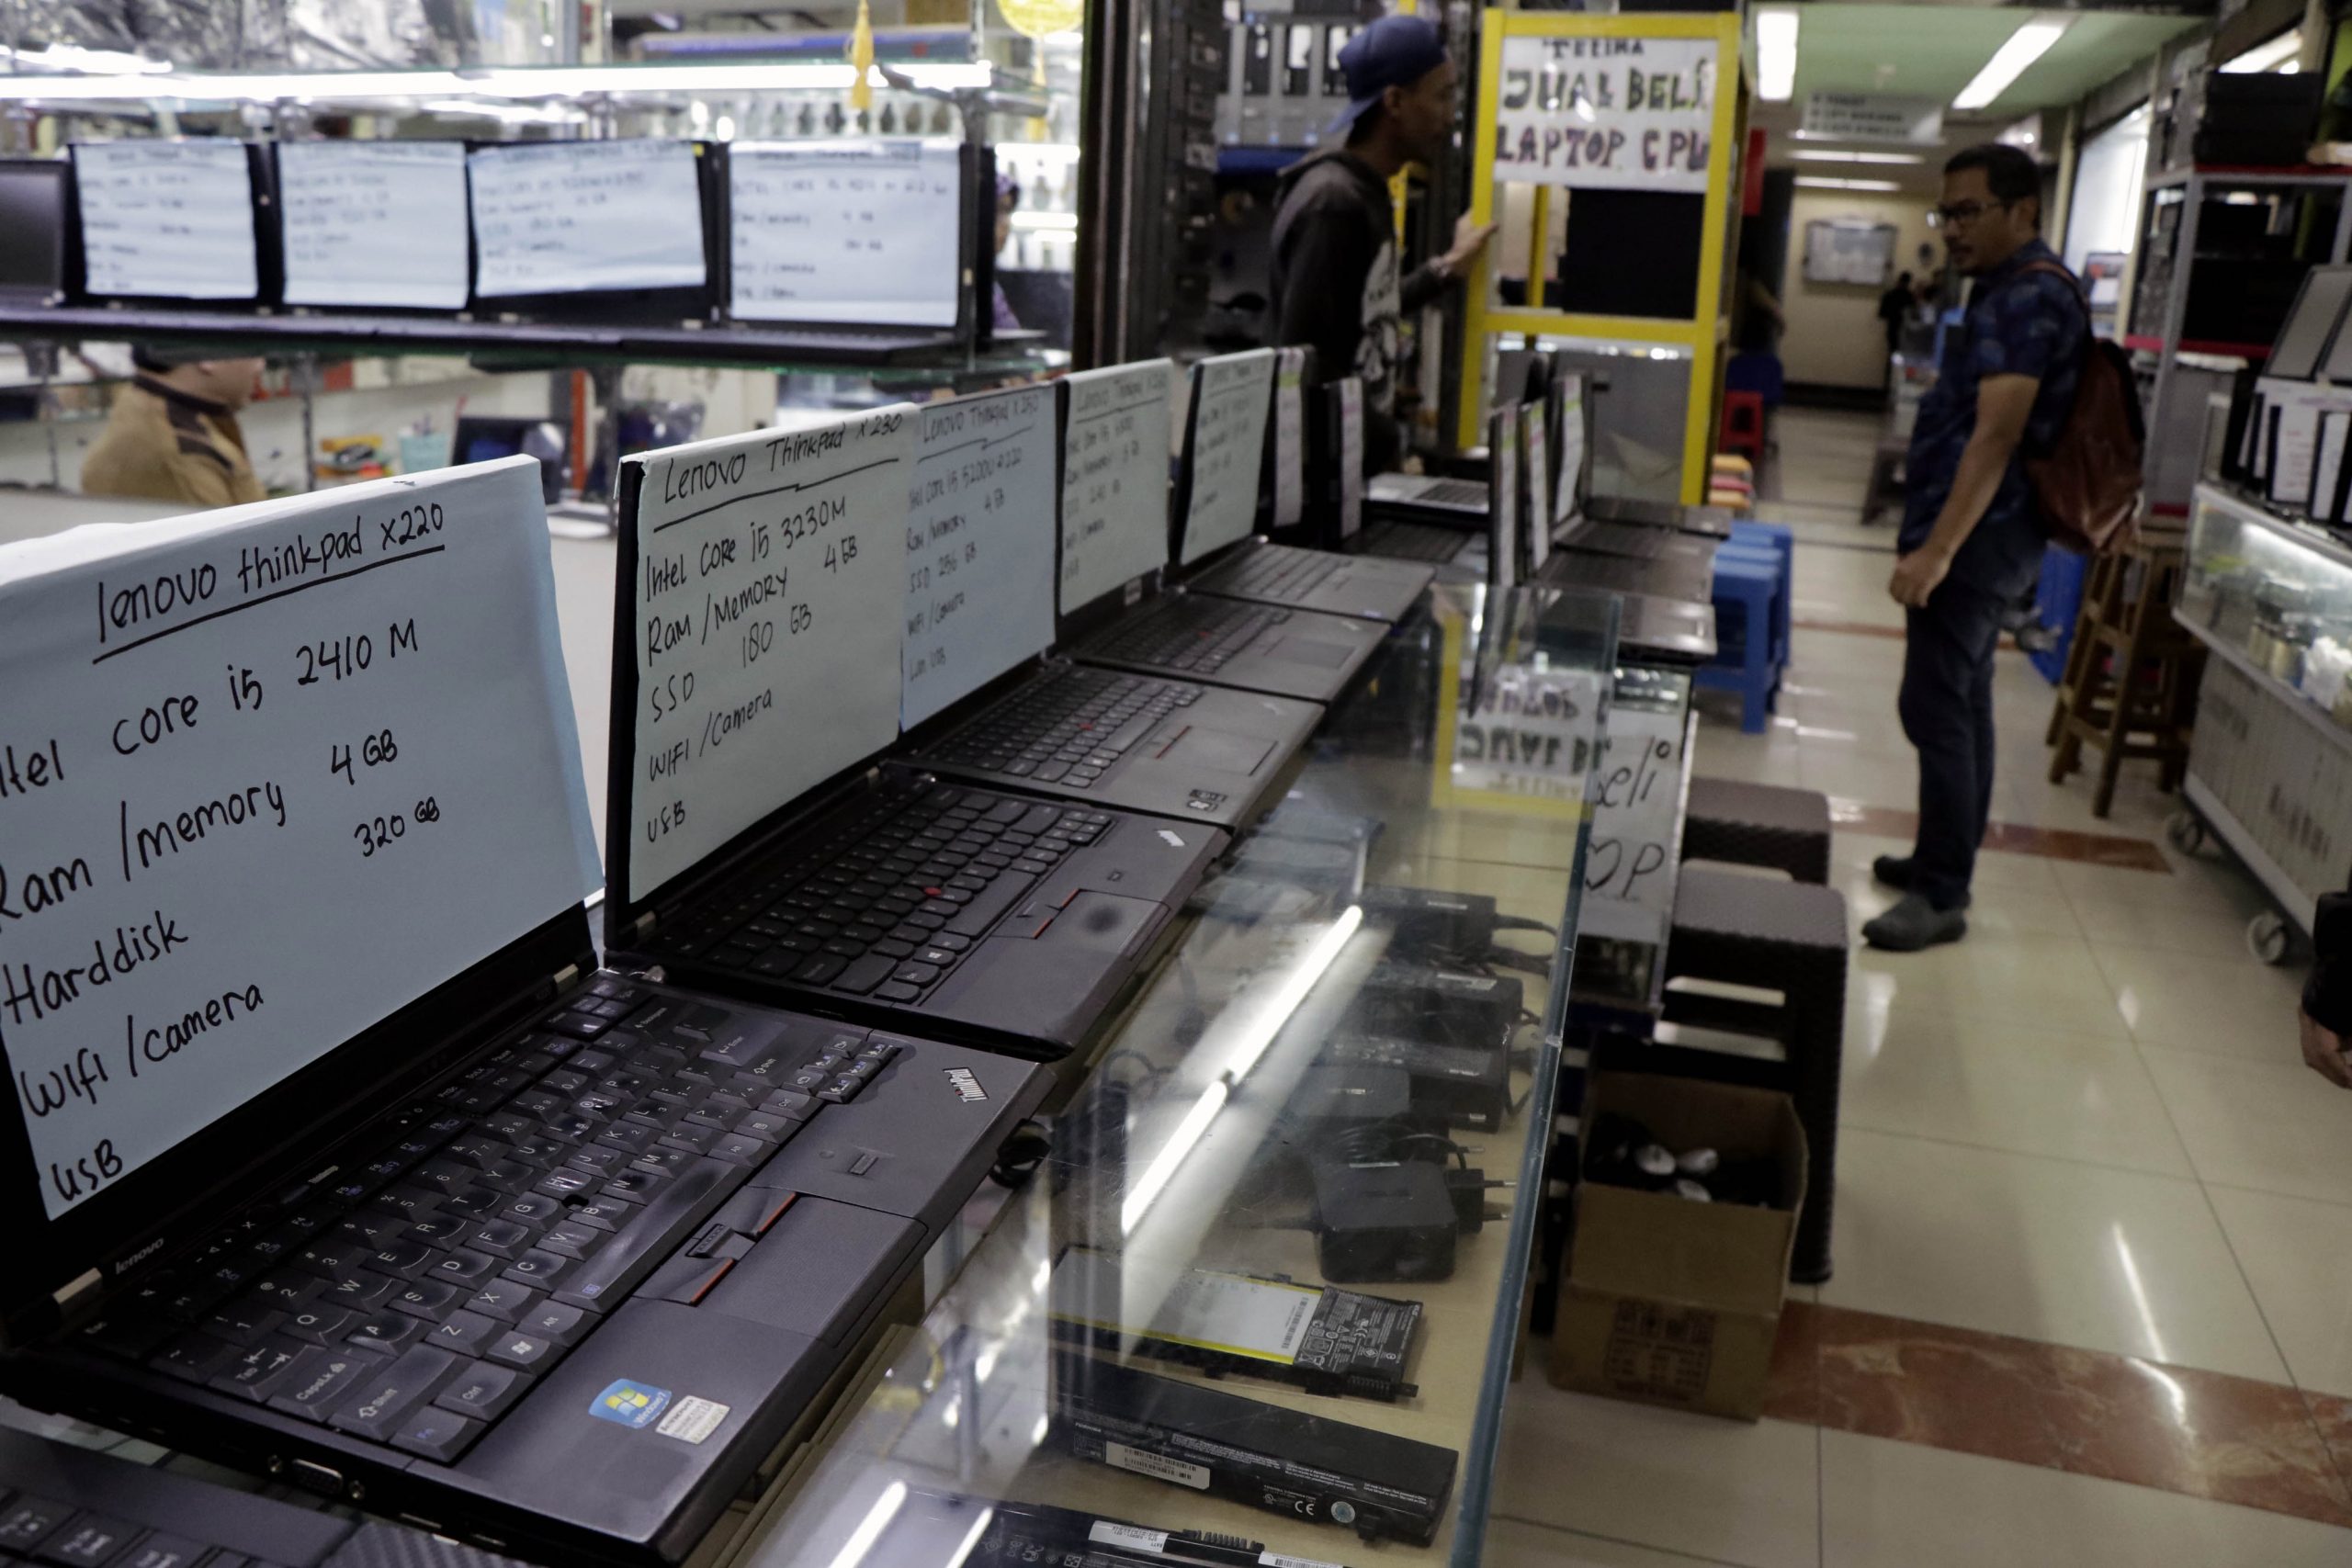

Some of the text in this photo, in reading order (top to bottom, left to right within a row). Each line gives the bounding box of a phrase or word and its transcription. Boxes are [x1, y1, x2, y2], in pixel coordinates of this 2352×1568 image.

[1504, 68, 1612, 111] JUAL
[1496, 125, 1710, 171] LAPTOP CPU
[664, 454, 747, 503] Lenovo
[98, 563, 217, 643] lenovo
[237, 515, 363, 594] thinkpad
[647, 554, 687, 603] Intel
[750, 522, 770, 563] i5
[781, 496, 846, 549] 3230M
[0, 739, 64, 798] tel
[227, 664, 264, 711] i5
[296, 635, 372, 686] 2410
[651, 671, 695, 723] SSD
[1594, 736, 1670, 809] eli
[2, 910, 189, 1025] Harddisk
[115, 1237, 165, 1275] lenovo
